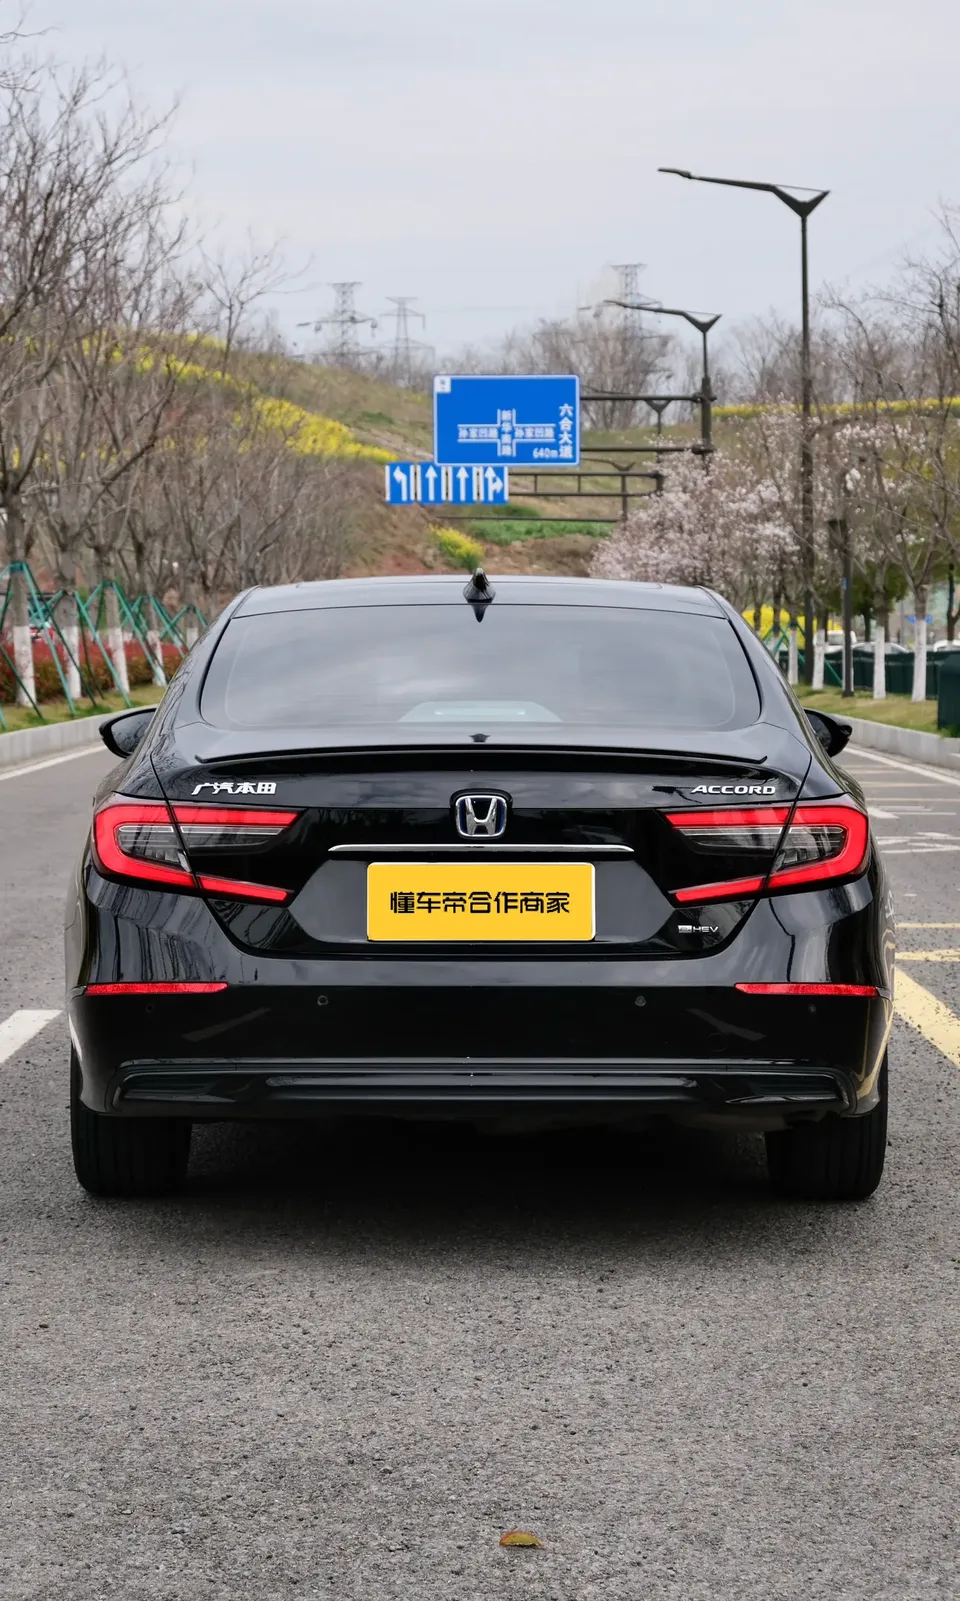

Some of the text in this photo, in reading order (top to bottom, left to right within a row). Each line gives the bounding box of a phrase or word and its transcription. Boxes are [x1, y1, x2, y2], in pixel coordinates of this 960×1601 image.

[558, 403, 574, 459] 六合大道
[532, 447, 558, 459] 640m
[191, 782, 277, 795] 广汽本田
[691, 785, 776, 795] ACCORD
[390, 891, 570, 914] 懂车帝合作商家
